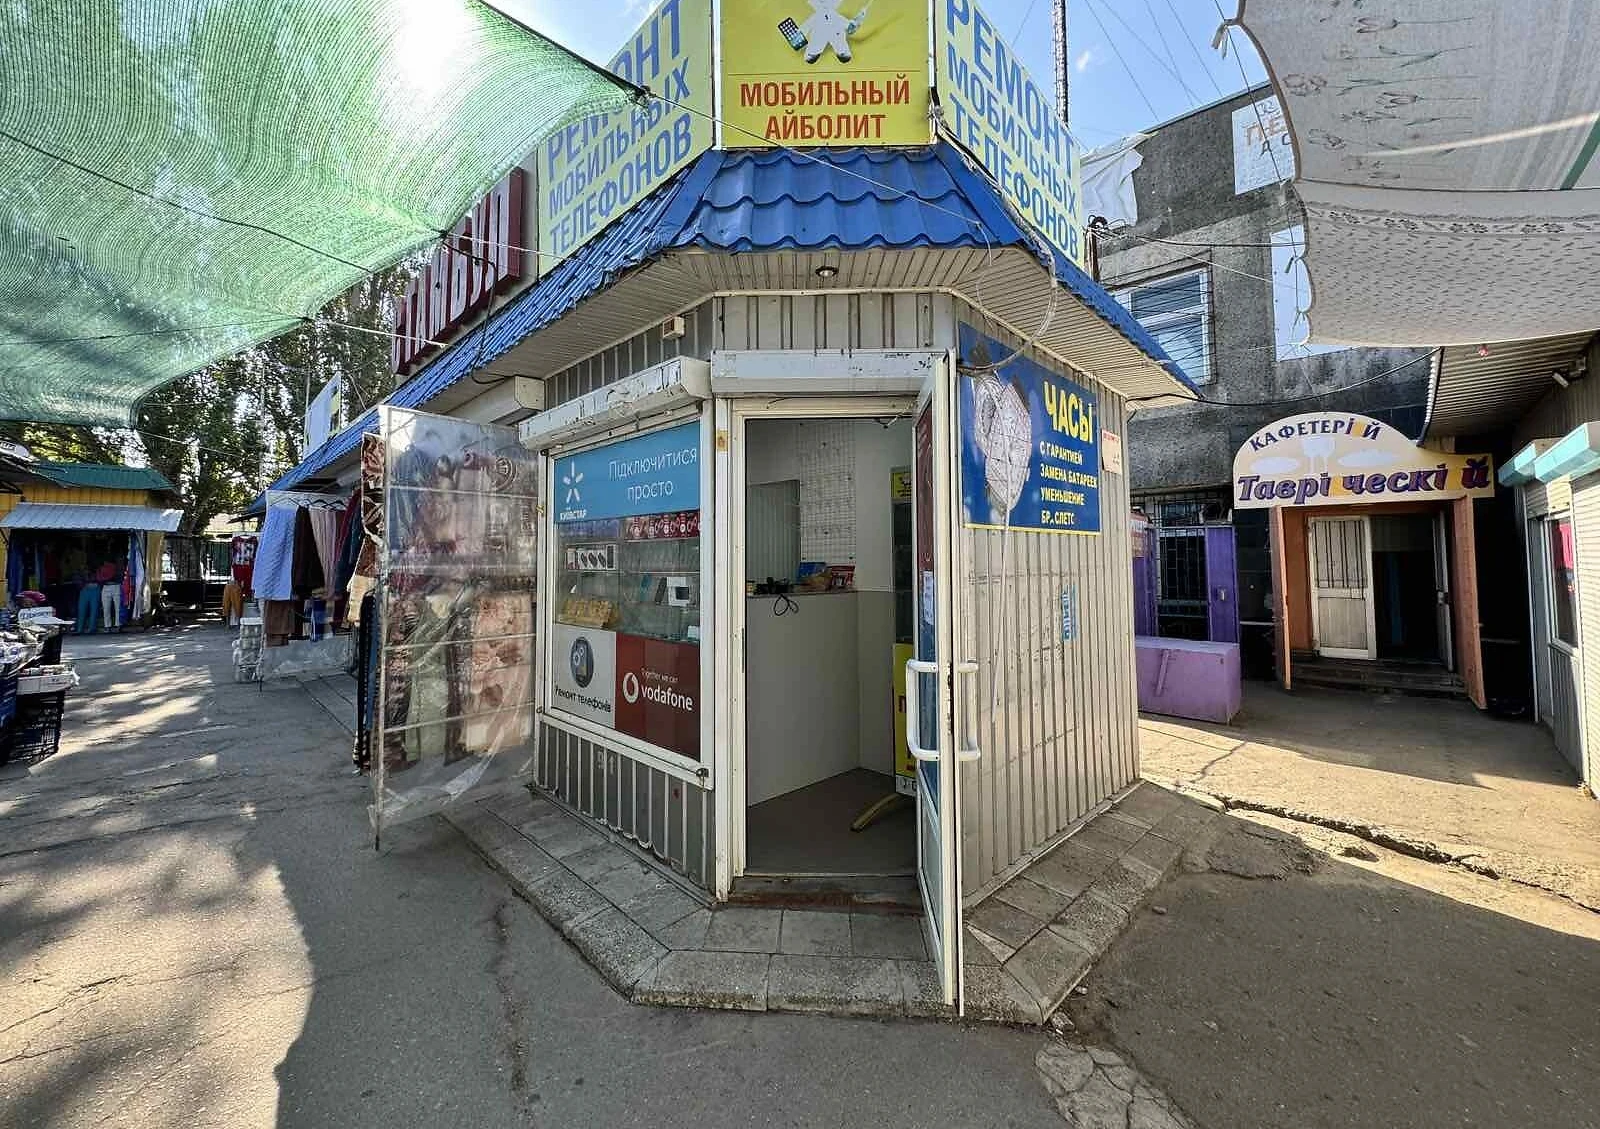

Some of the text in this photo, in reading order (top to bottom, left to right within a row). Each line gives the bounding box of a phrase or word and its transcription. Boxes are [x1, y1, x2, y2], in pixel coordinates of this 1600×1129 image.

[740, 73, 910, 107] МОБИЛЬНЫЙ
[946, 0, 1074, 178] РЕМОНТ
[551, 56, 690, 219] МОБИЛЬНЫХ
[765, 109, 887, 140] АЙБОЛИТ
[947, 41, 1077, 218] МОБИЛЬНЫХ
[550, 112, 692, 253] ТЕЛЕФОНОВ
[949, 92, 1079, 259] ТЕЛЕФОНОВ
[1044, 381, 1094, 444] ЧАСЫ
[608, 448, 697, 481] Підключитися
[1046, 442, 1083, 466] ГАРАНТИЕЙ
[1040, 462, 1067, 482] ЗАМЕНА
[627, 480, 674, 505] просто
[1040, 486, 1086, 506] УМЕНЬШЕНИЕ
[641, 684, 693, 711] vodafone
